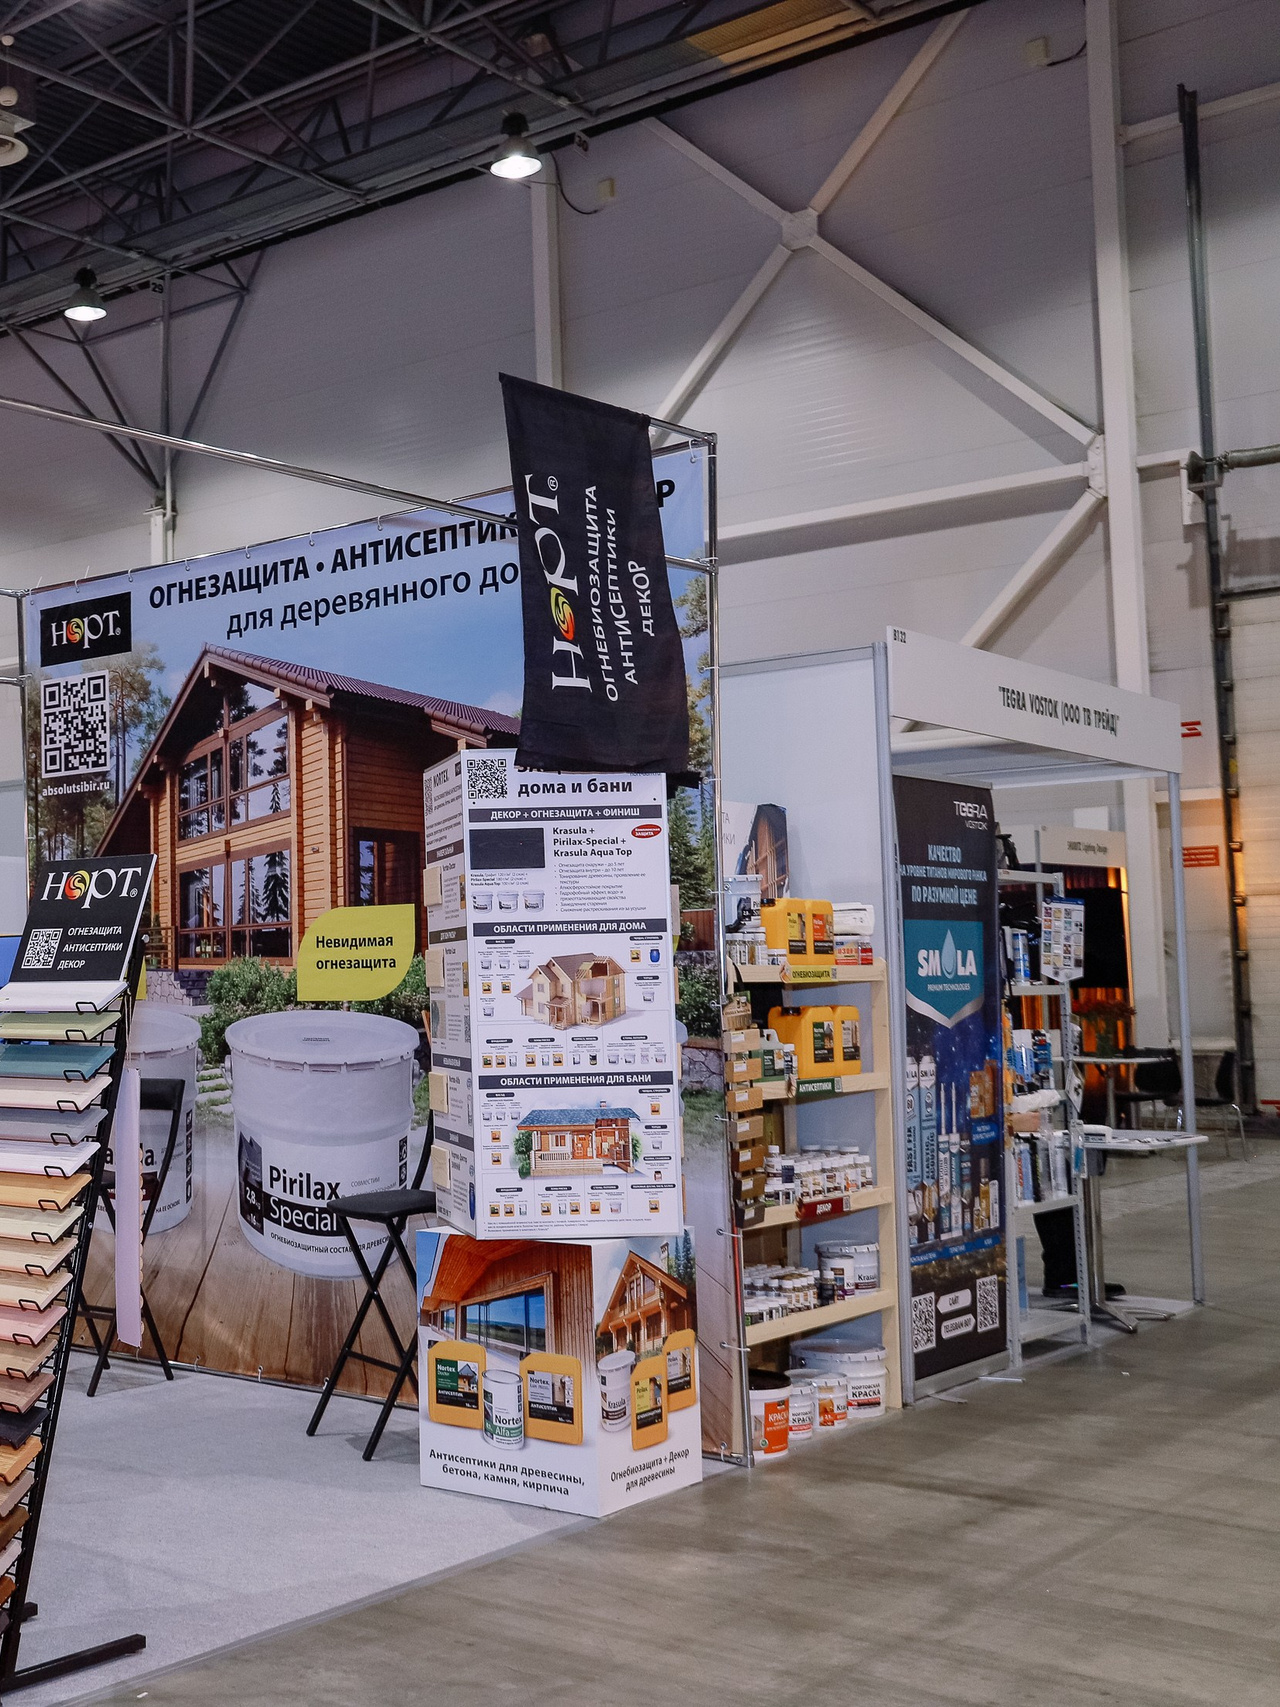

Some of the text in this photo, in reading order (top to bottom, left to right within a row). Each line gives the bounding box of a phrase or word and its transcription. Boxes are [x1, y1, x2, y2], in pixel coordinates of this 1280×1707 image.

[149, 511, 518, 609] ОГНЕЗАЩИТА АНТИСЕПТИК
[226, 562, 519, 640] для деревянного до
[585, 484, 619, 702] ОГНЕБИОЗАЩИТА
[605, 508, 639, 685] АНТИСЕПТИКИ
[628, 560, 656, 637] ДЕКОР
[1029, 693, 1059, 720] VOSTOK
[1082, 707, 1091, 727] ТВ
[42, 781, 110, 797] absolutsibir.ru
[518, 778, 633, 798] дома и бани
[490, 810, 522, 821] ДЕКОР
[530, 808, 594, 819] ОГНЕЗАЩИТА
[603, 807, 640, 817] ФИНИШ
[953, 800, 988, 820] TEGRA
[552, 826, 587, 835] Krasula
[553, 837, 619, 847] Pirilax-Special
[553, 848, 633, 860] Krasula Aqua Top
[927, 844, 962, 863] КАЧЕСТВО
[911, 884, 978, 908] ПО РАЗУМНОЙ ЦЕНЕ
[67, 926, 122, 937] ОГНЕЗАЩИТА
[493, 921, 647, 933] ОБЛАСТИ ПРИМЕНЕНИЯ ДЛЯ ДОМА
[62, 943, 124, 953] АНТИСЕПТИКИ
[315, 934, 394, 951] Невидимая
[57, 960, 86, 970] ДЕКОР
[315, 957, 397, 973] огнезащита
[792, 970, 831, 979] ОГНЕБИОЗАЩИТА
[500, 1074, 652, 1086] ОБЛАСТИ ПРИМЕНЕНИЯ ДЛЯ БАНИ
[799, 1081, 832, 1093] АНТИСЕПТИКИ
[269, 1165, 341, 1201] Pirilax
[270, 1196, 337, 1232] Special
[816, 1202, 832, 1215] ДЕКОР
[270, 1232, 329, 1254] ОГНЕБИОЗАЩИТНЫЙ
[366, 1235, 392, 1251] ДРЕВЕСИ
[851, 1389, 881, 1398] КРАСКА
[495, 1427, 510, 1437] Alfa
[429, 1449, 585, 1486] Антисептики для древесины,
[610, 1448, 690, 1483] Огнебиозащита Декор
[442, 1464, 569, 1496] бетона, камня, кирпича
[625, 1466, 676, 1493] для древесины
